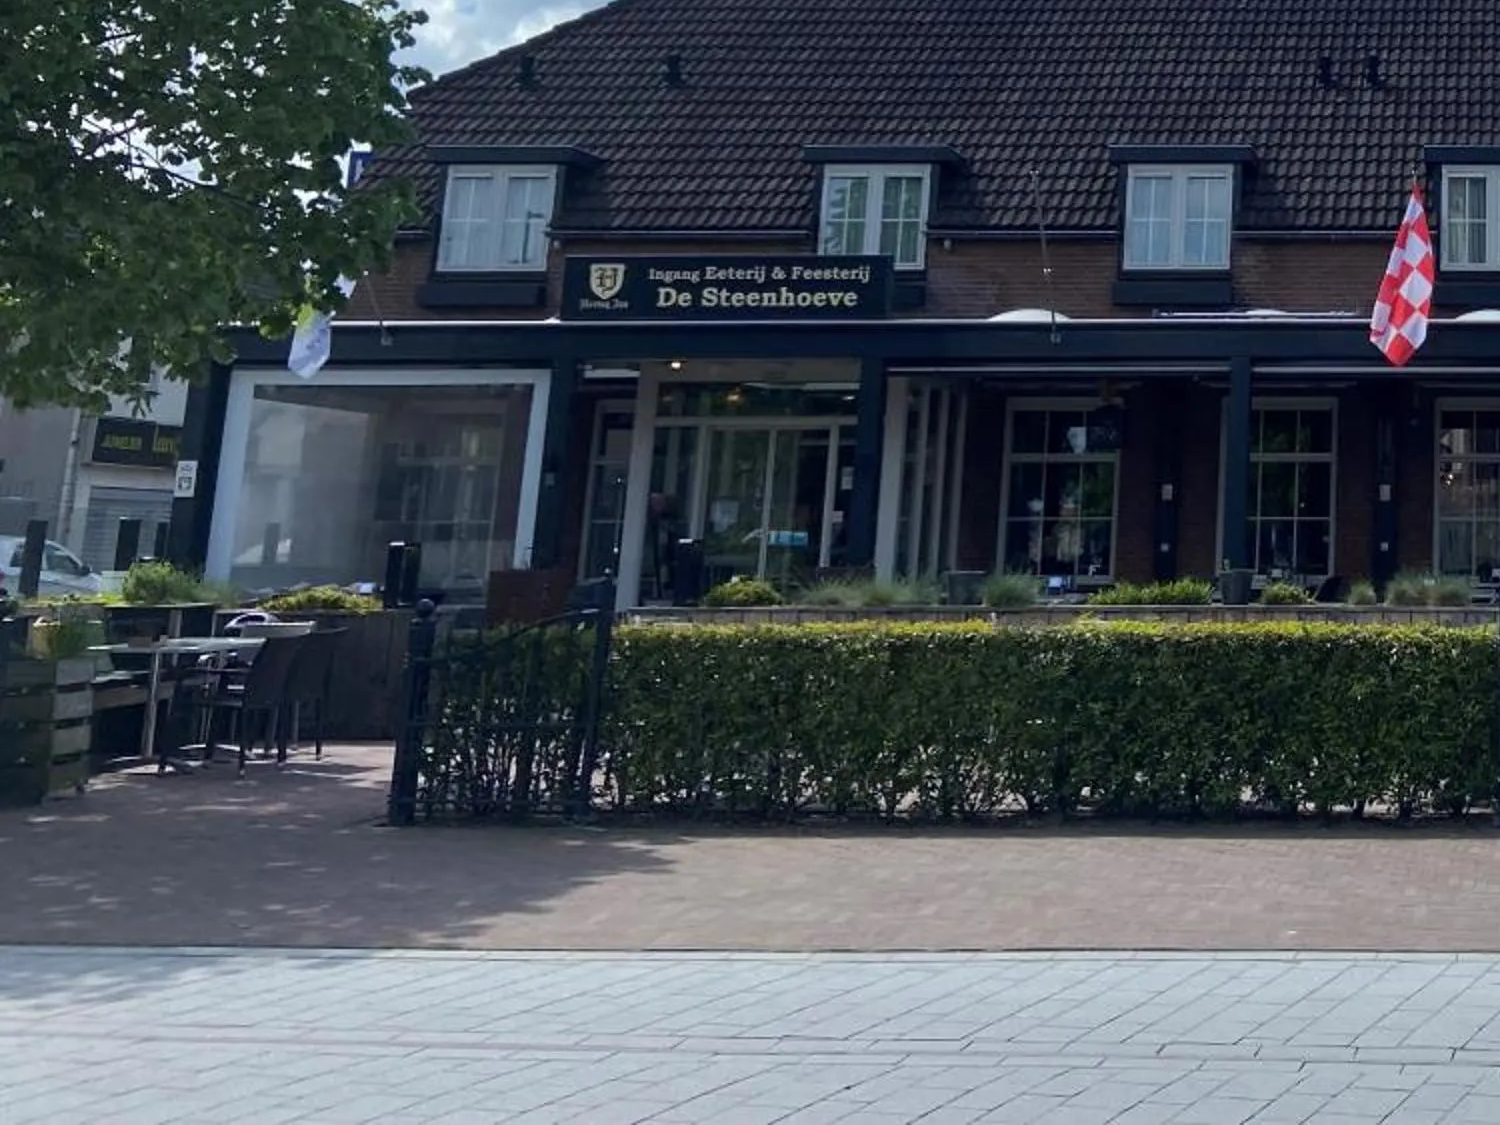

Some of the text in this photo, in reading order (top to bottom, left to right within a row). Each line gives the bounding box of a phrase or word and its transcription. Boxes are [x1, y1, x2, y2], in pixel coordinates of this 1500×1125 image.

[649, 266, 871, 283] Ingang Eeterij & Feesterij
[657, 287, 858, 307] De Steenhoeve
